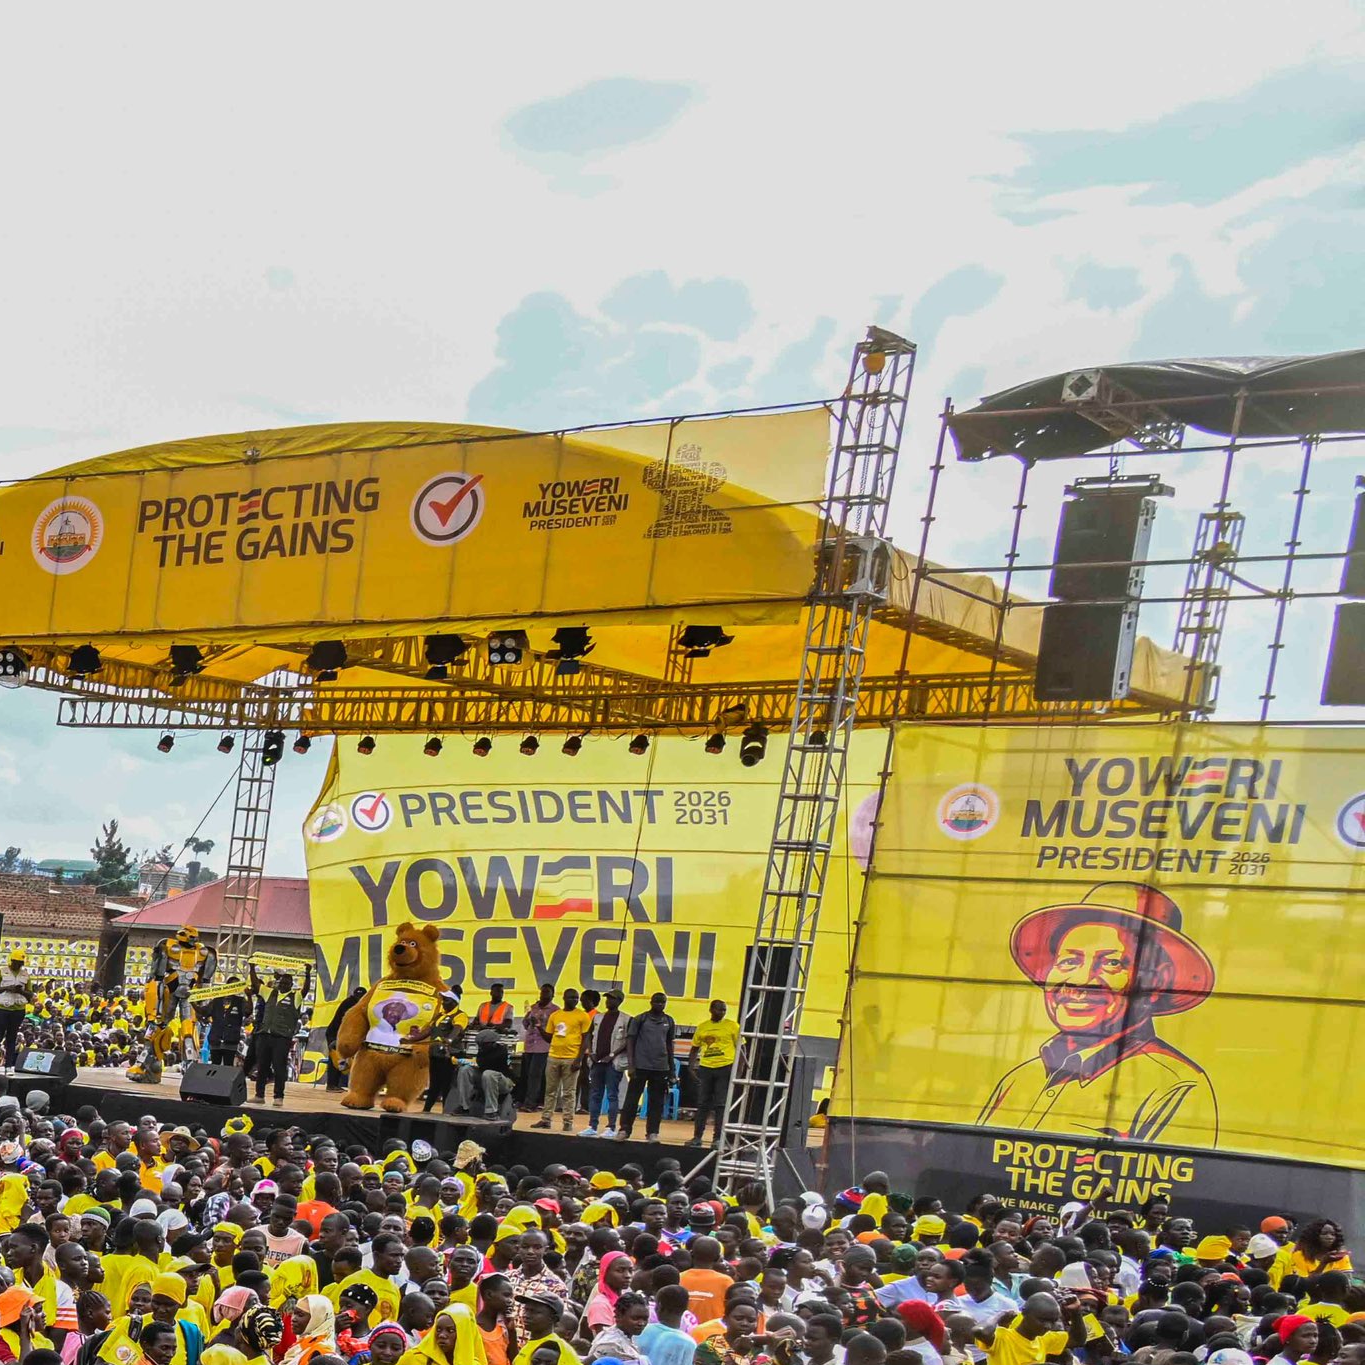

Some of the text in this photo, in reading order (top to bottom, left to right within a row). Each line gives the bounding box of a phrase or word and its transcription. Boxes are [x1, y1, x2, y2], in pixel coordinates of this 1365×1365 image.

[137, 477, 381, 534] PROTECTING
[522, 494, 629, 519] MUSEVENI
[538, 477, 619, 500] YOWERI
[529, 515, 601, 531] PRESIDENT
[153, 519, 355, 568] THE GAINS
[1064, 756, 1283, 799] YOWERI
[398, 789, 731, 828] PRESIDENT 2026
[674, 808, 729, 826] 2031
[1021, 800, 1307, 845] MUSEVENI
[1036, 845, 1270, 874] PRESIDENT 2026
[1228, 863, 1266, 876] 2031
[349, 855, 673, 927] YOWERI
[992, 1139, 1194, 1183] PROTECTING
[1005, 1166, 1173, 1206] THE GAINS
[1019, 1199, 1054, 1213] MAKE
